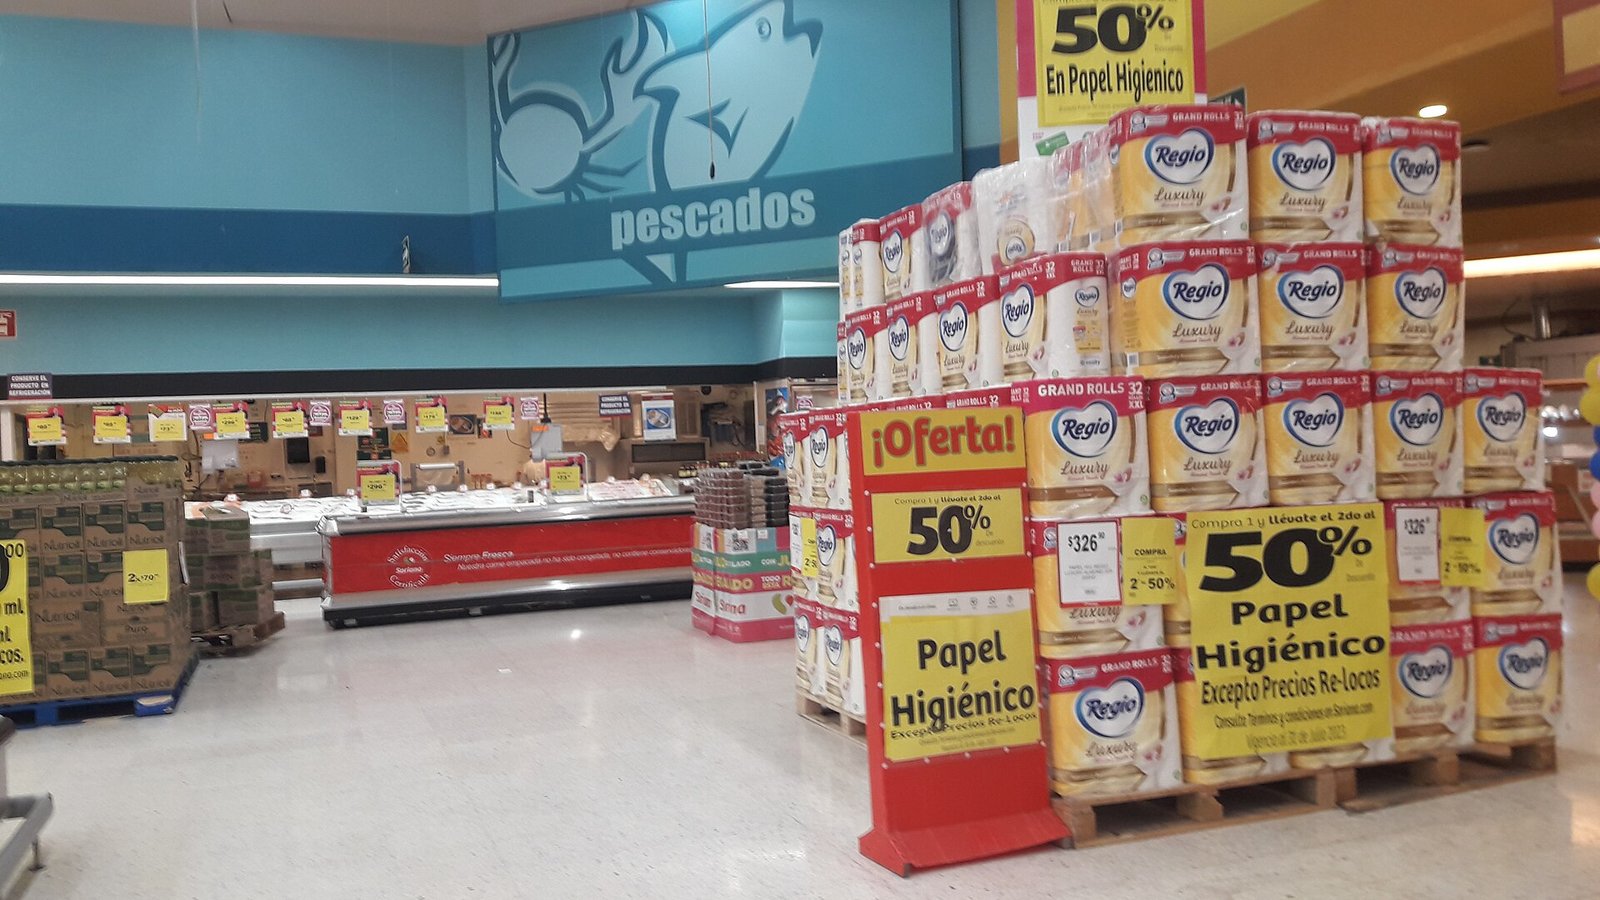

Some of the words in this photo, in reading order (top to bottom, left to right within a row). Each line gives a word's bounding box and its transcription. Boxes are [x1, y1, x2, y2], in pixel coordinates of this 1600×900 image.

[1051, 4, 1174, 54] 50%
[1046, 64, 1066, 96] En
[1068, 61, 1112, 101] Papel
[1115, 59, 1184, 102] Higienico
[1173, 112, 1201, 123] GRAND
[1155, 145, 1205, 167] Regio
[1282, 153, 1328, 173] Regio
[1398, 157, 1435, 178] Regio
[1154, 187, 1207, 206] Luxury
[1279, 193, 1327, 212] Luxury
[611, 187, 816, 250] pescados
[1189, 248, 1218, 257] GRAND
[1219, 248, 1243, 256] ROLLS
[1304, 250, 1331, 258] GRAND
[1046, 261, 1056, 269] 32
[976, 281, 985, 290] 32
[1173, 281, 1222, 303] Regio
[1288, 280, 1337, 301] Regio
[1403, 282, 1441, 302] Regio
[1005, 300, 1029, 322] Regio
[943, 317, 964, 337] Regio
[1172, 323, 1223, 343] Luxury
[1286, 321, 1335, 341] Luxury
[850, 338, 864, 356] Regio
[890, 329, 907, 348] Regio
[1005, 340, 1029, 357] Luxury
[1038, 383, 1083, 397] GRAND
[1087, 383, 1124, 395] ROLLS
[1128, 381, 1143, 394] 32
[1201, 383, 1228, 391] GRAND
[970, 396, 987, 406] ROLLS
[989, 394, 999, 404] 32
[1128, 401, 1144, 409] XXL
[1185, 414, 1232, 437] Regio
[1293, 408, 1337, 431] Regio
[1397, 408, 1437, 429] Regio
[1484, 406, 1520, 426] Regio
[1062, 417, 1110, 440] Regio
[871, 414, 1016, 469] ¡Oferta!
[1184, 456, 1232, 476] Luxury
[1293, 449, 1339, 468] Luxury
[1060, 460, 1110, 479] Luxury
[894, 497, 926, 506] Compra
[941, 495, 968, 503] llévate
[907, 505, 991, 555] 50%
[1191, 518, 1243, 530] Compra
[1247, 517, 1253, 526] 1
[1258, 518, 1265, 528] y
[1269, 513, 1317, 525] llévate
[1319, 511, 1333, 521] el
[1338, 511, 1361, 521] 2do
[1364, 510, 1376, 519] al
[1404, 518, 1425, 534] $326
[1068, 534, 1098, 552] $326
[1497, 528, 1534, 548] Regio
[5, 542, 24, 558] 00
[1134, 548, 1167, 556] COMPRA
[1198, 526, 1372, 593] 50%
[5, 597, 24, 615] ml.
[1230, 593, 1348, 628] Papel
[917, 629, 1007, 675] Papel
[1196, 632, 1385, 673] Higiénico
[1101, 662, 1131, 673] GRAND
[1202, 675, 1260, 709] Excepto
[1262, 669, 1316, 700] Precios
[891, 679, 1035, 733] Higiénico
[1085, 694, 1136, 719] Regio
